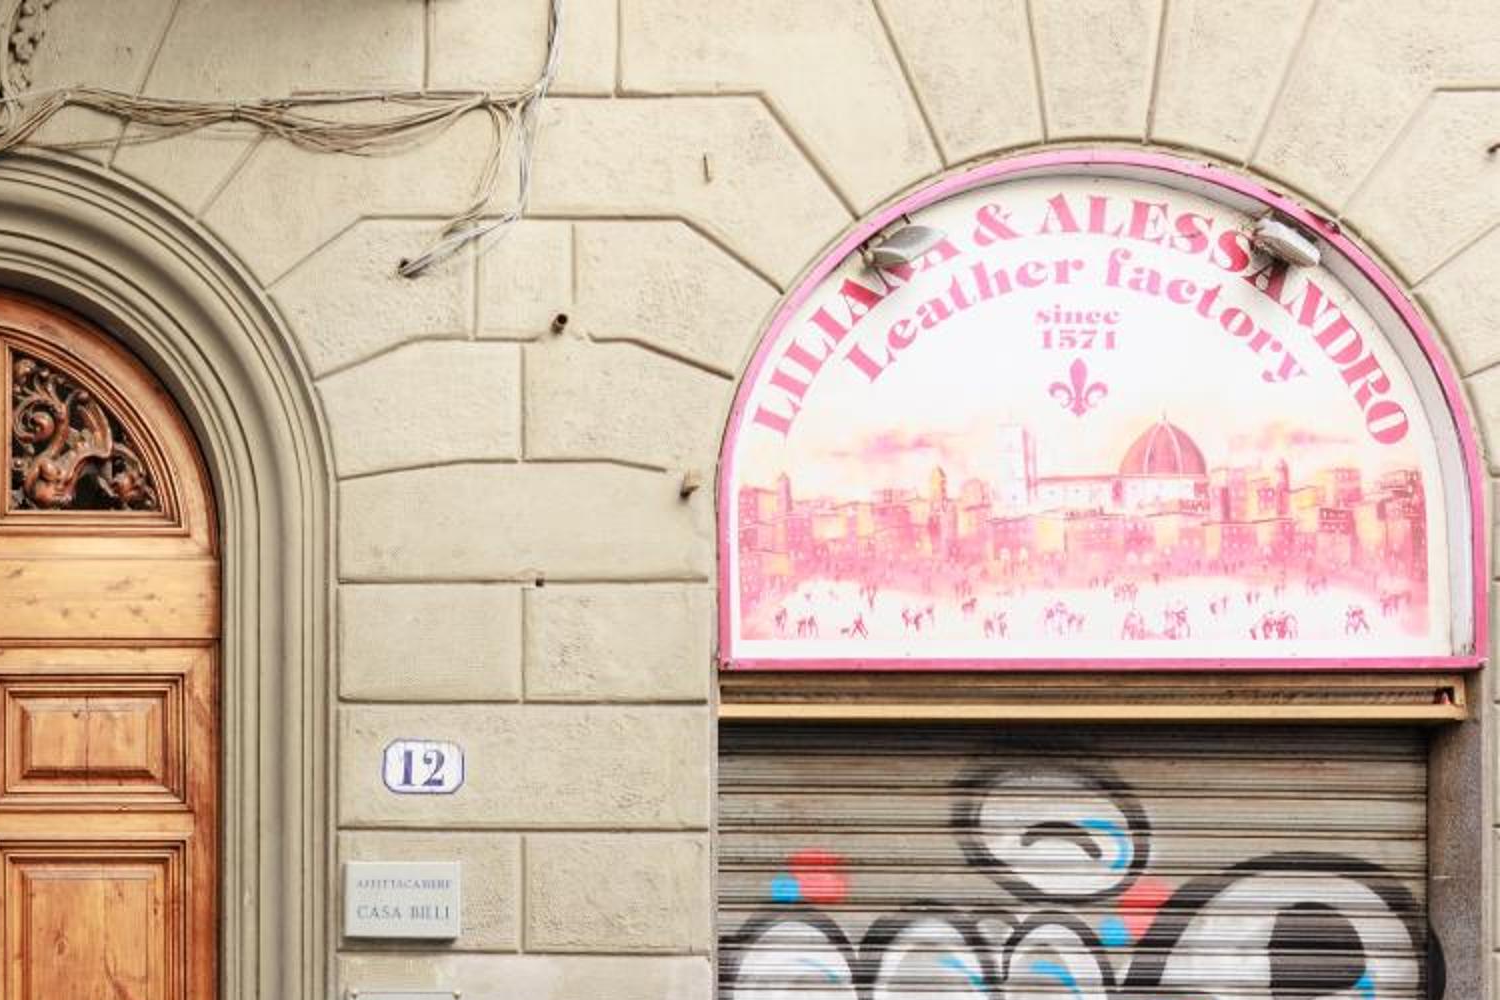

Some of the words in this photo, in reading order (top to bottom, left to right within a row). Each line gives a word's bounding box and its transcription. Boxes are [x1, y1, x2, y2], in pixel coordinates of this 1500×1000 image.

[973, 202, 1023, 248] &
[844, 252, 1084, 383] Leather
[1105, 247, 1309, 383] factory
[1035, 303, 1122, 325] since
[1041, 328, 1116, 350] 1571
[399, 749, 445, 787] 12
[357, 904, 402, 920] CASA
